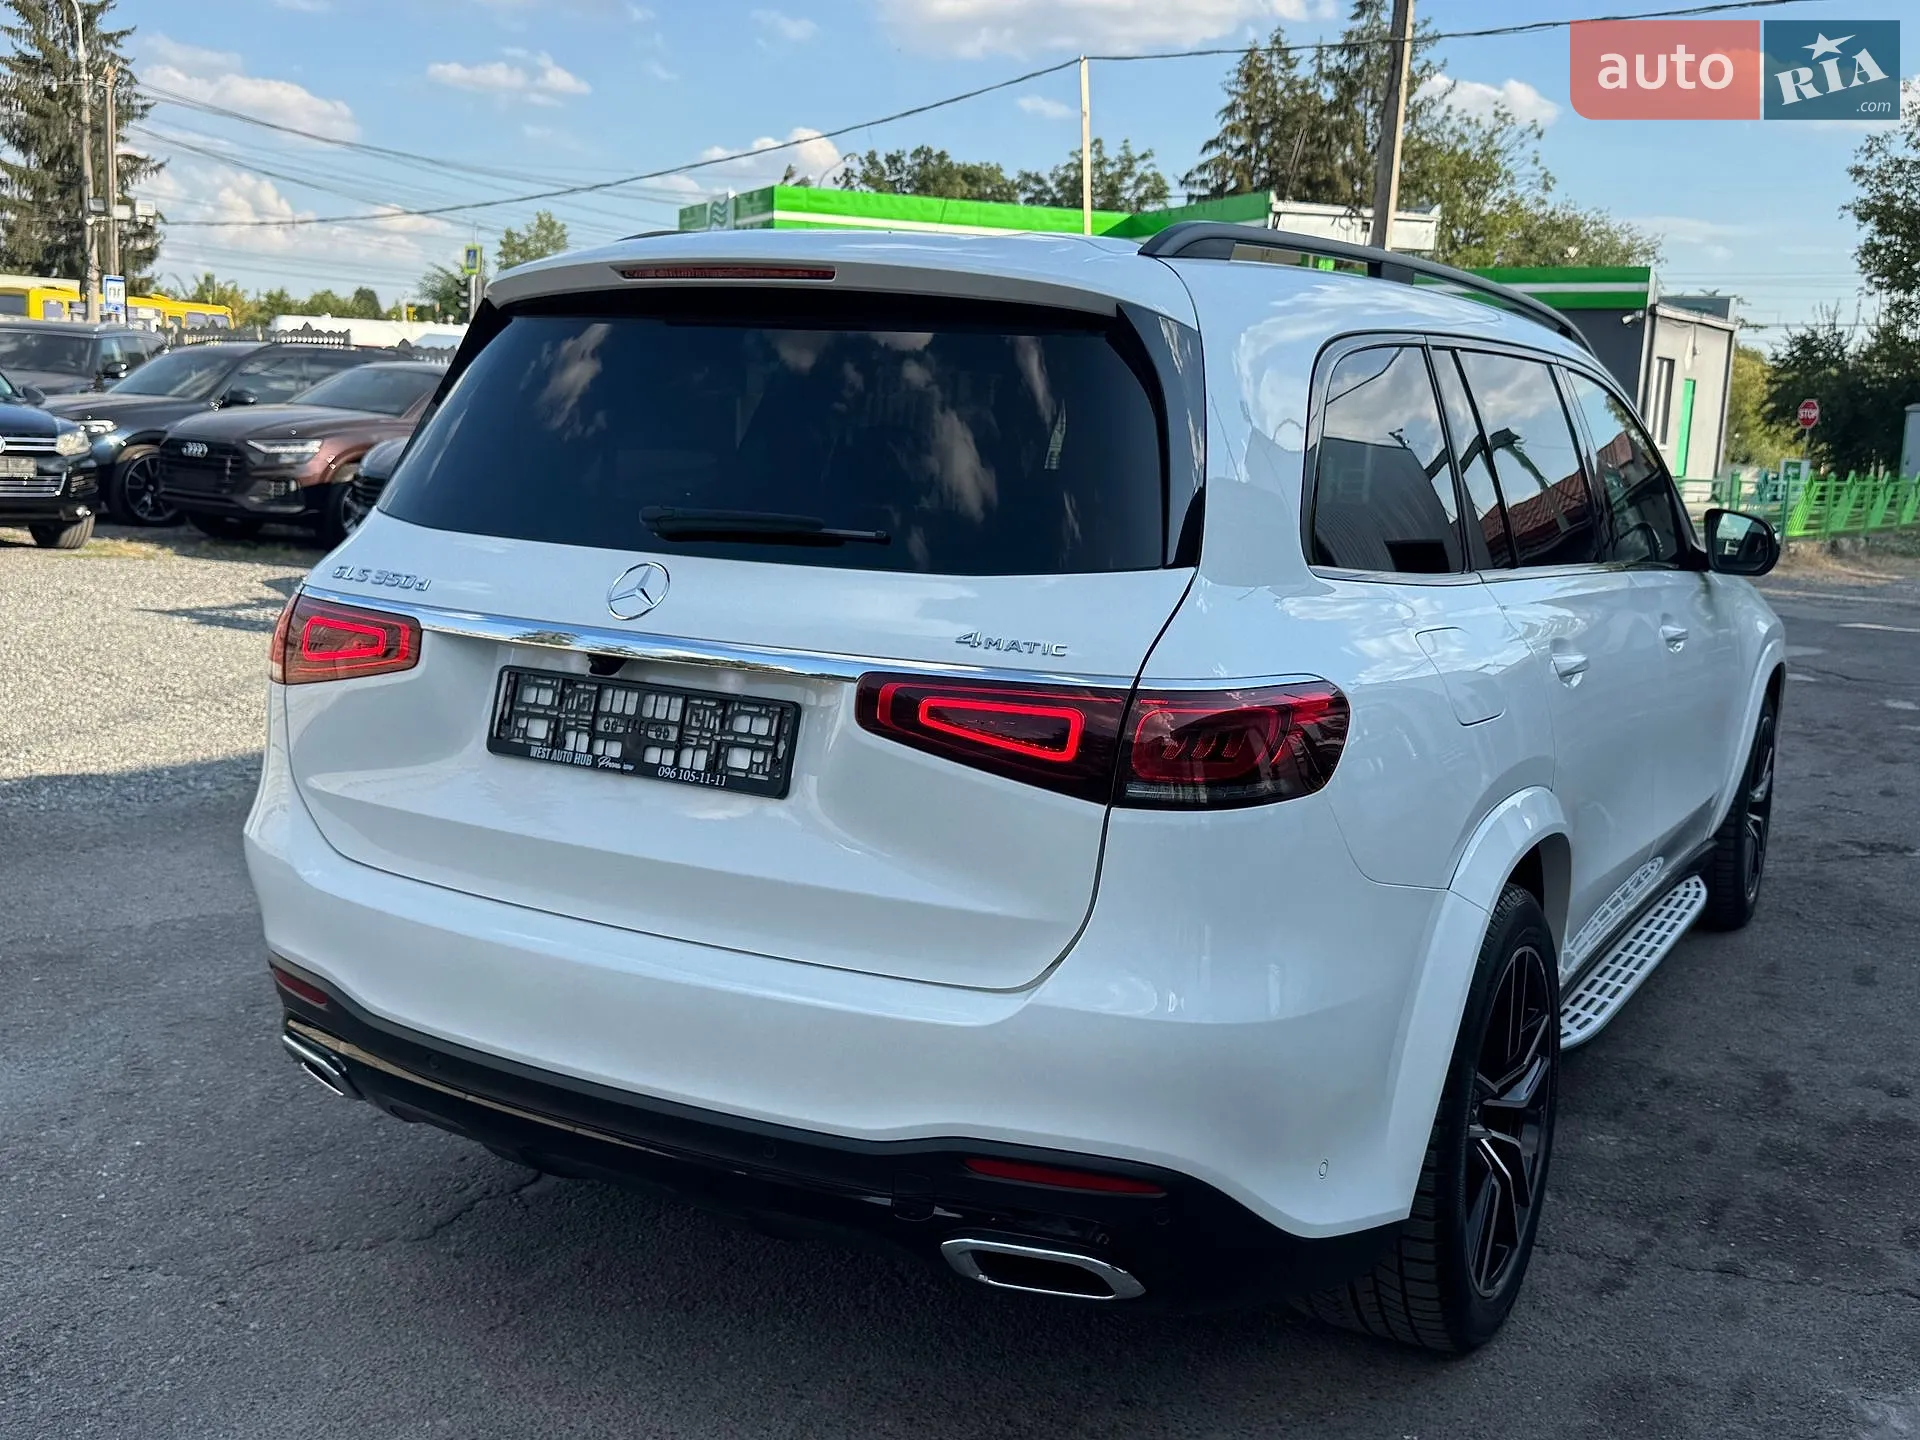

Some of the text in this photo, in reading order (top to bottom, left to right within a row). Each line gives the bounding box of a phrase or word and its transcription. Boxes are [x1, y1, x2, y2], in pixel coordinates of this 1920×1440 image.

[332, 565, 432, 592] GLS 350d
[955, 631, 1067, 657] 4MATIC
[529, 745, 552, 760] WEST
[551, 749, 573, 763] AUTO
[573, 753, 593, 766] HUB
[657, 766, 726, 787] 096 105-11-11
